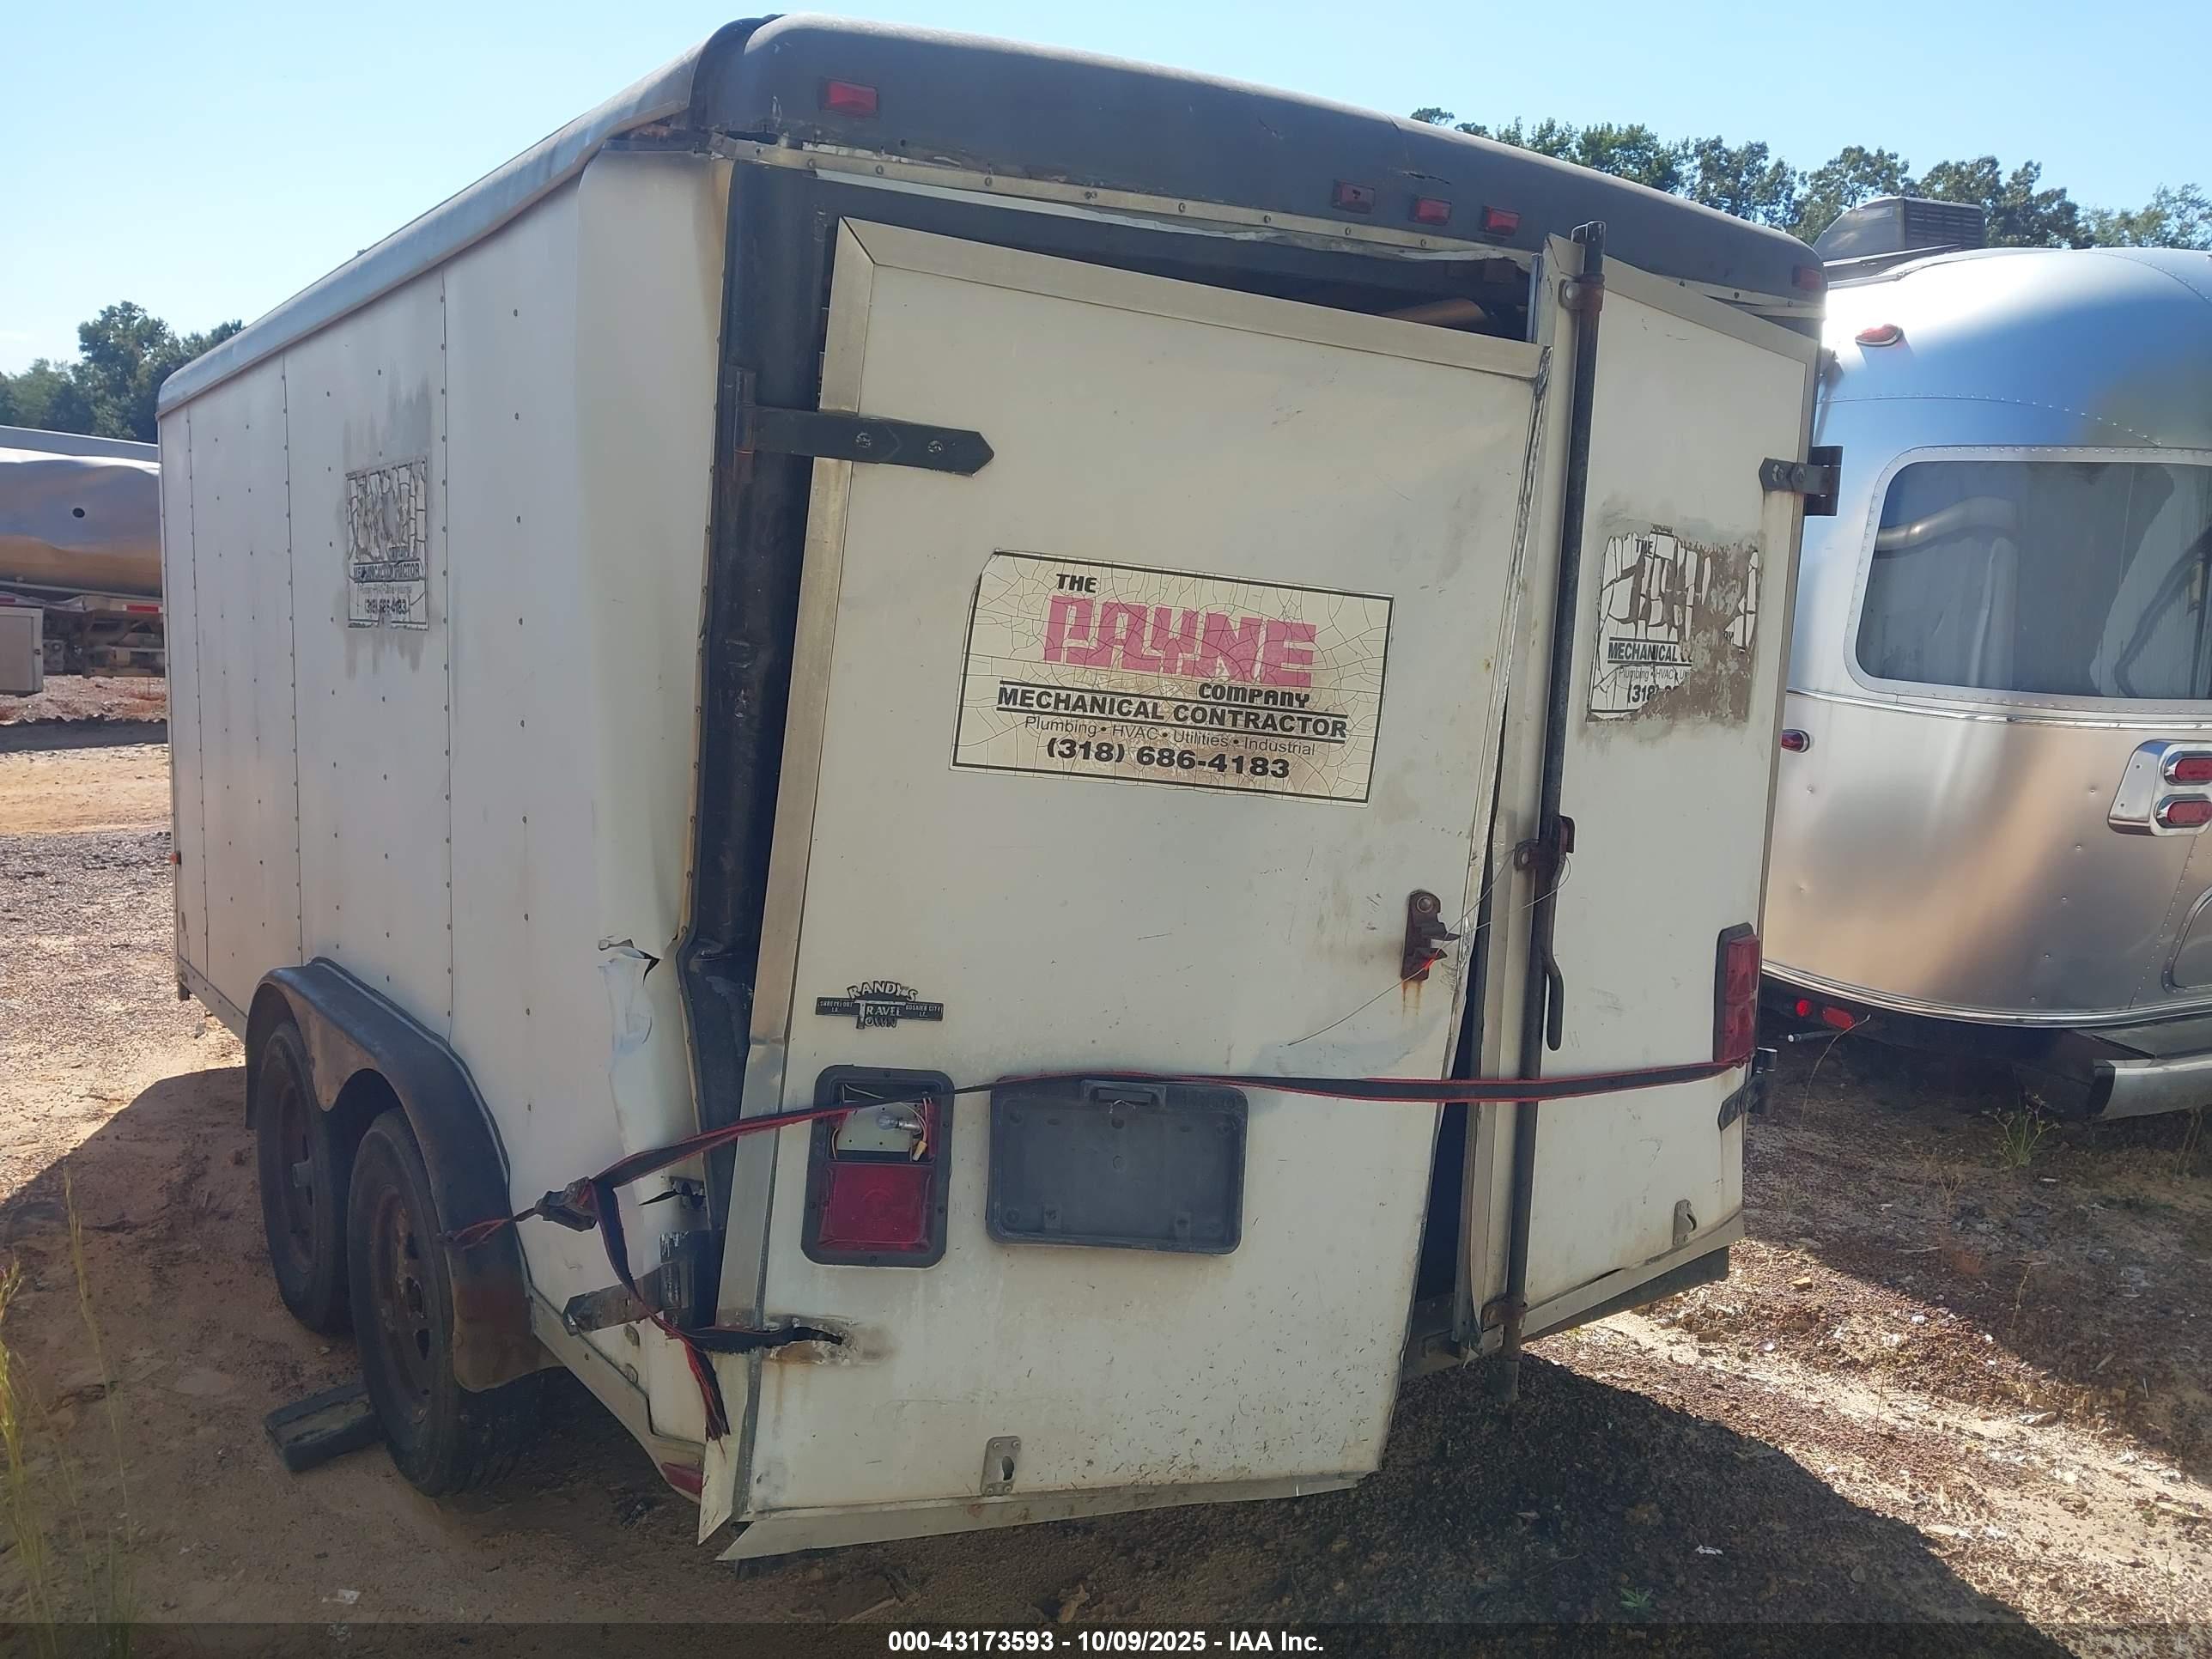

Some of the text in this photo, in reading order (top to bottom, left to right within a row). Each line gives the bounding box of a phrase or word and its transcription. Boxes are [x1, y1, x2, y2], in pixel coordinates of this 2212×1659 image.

[1056, 574, 1097, 593] THE
[1043, 595, 1317, 688] PAYNE
[1607, 641, 1678, 663] MECHANICAL
[1619, 666, 1650, 683] Plumbing
[1656, 668, 1674, 680] HVAC
[1198, 683, 1310, 708] COMPANY
[998, 686, 1347, 738] MECHANICAL CONTRACTOR
[1024, 715, 1316, 756] Plumbing HVAC Utilities Industrial
[1047, 737, 1291, 779] (318) 686-4183
[854, 1000, 906, 1022] TRAVEL
